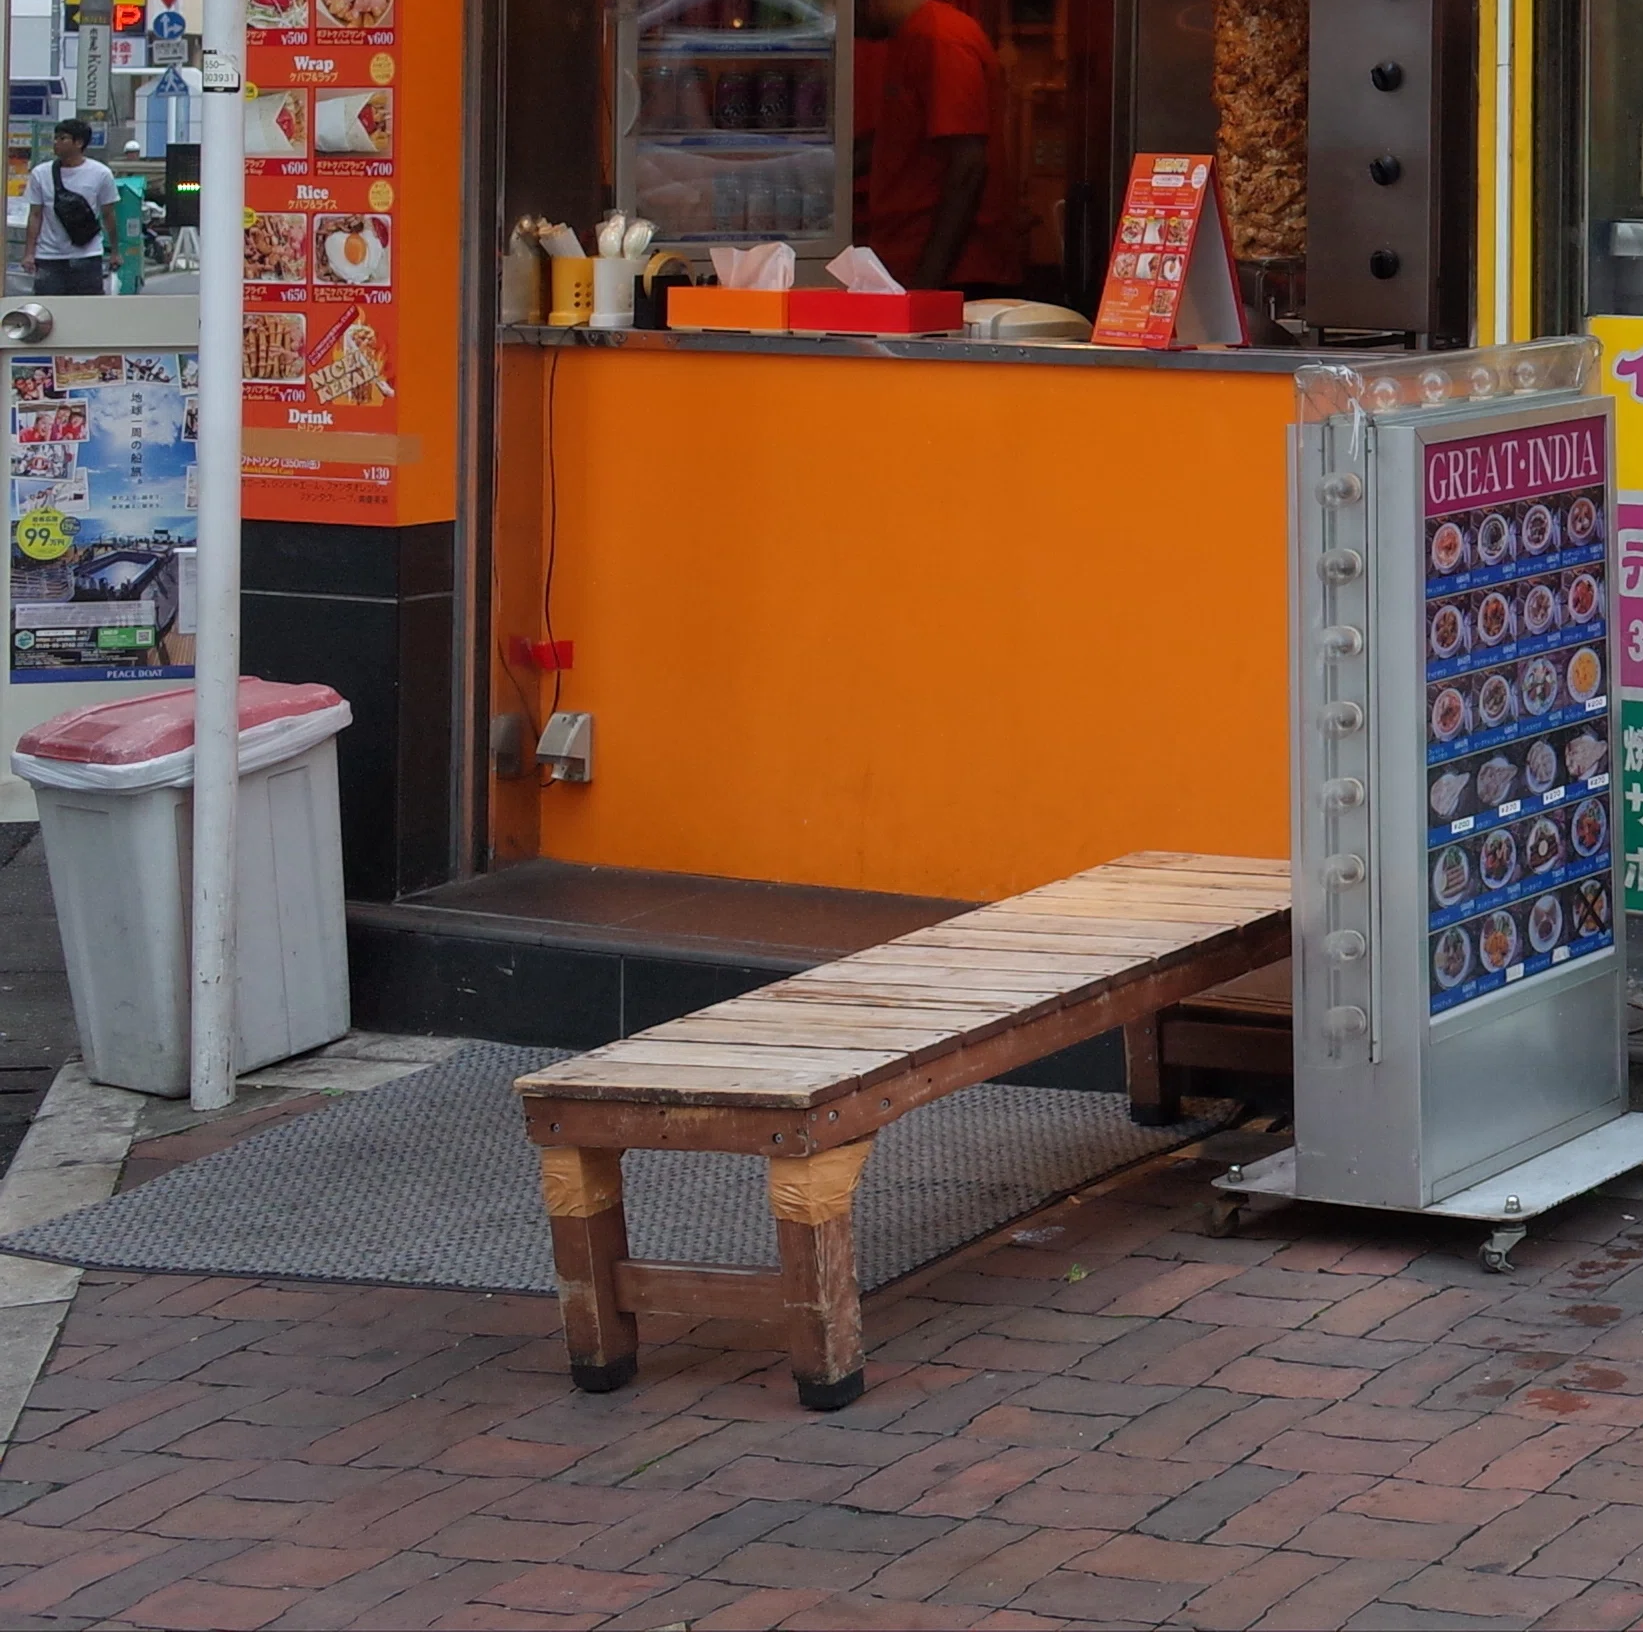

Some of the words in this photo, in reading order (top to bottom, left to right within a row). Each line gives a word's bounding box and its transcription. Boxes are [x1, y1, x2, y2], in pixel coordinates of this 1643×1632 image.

[294, 56, 334, 72] Wrap
[297, 186, 328, 200] Rice
[288, 409, 333, 425] Drink
